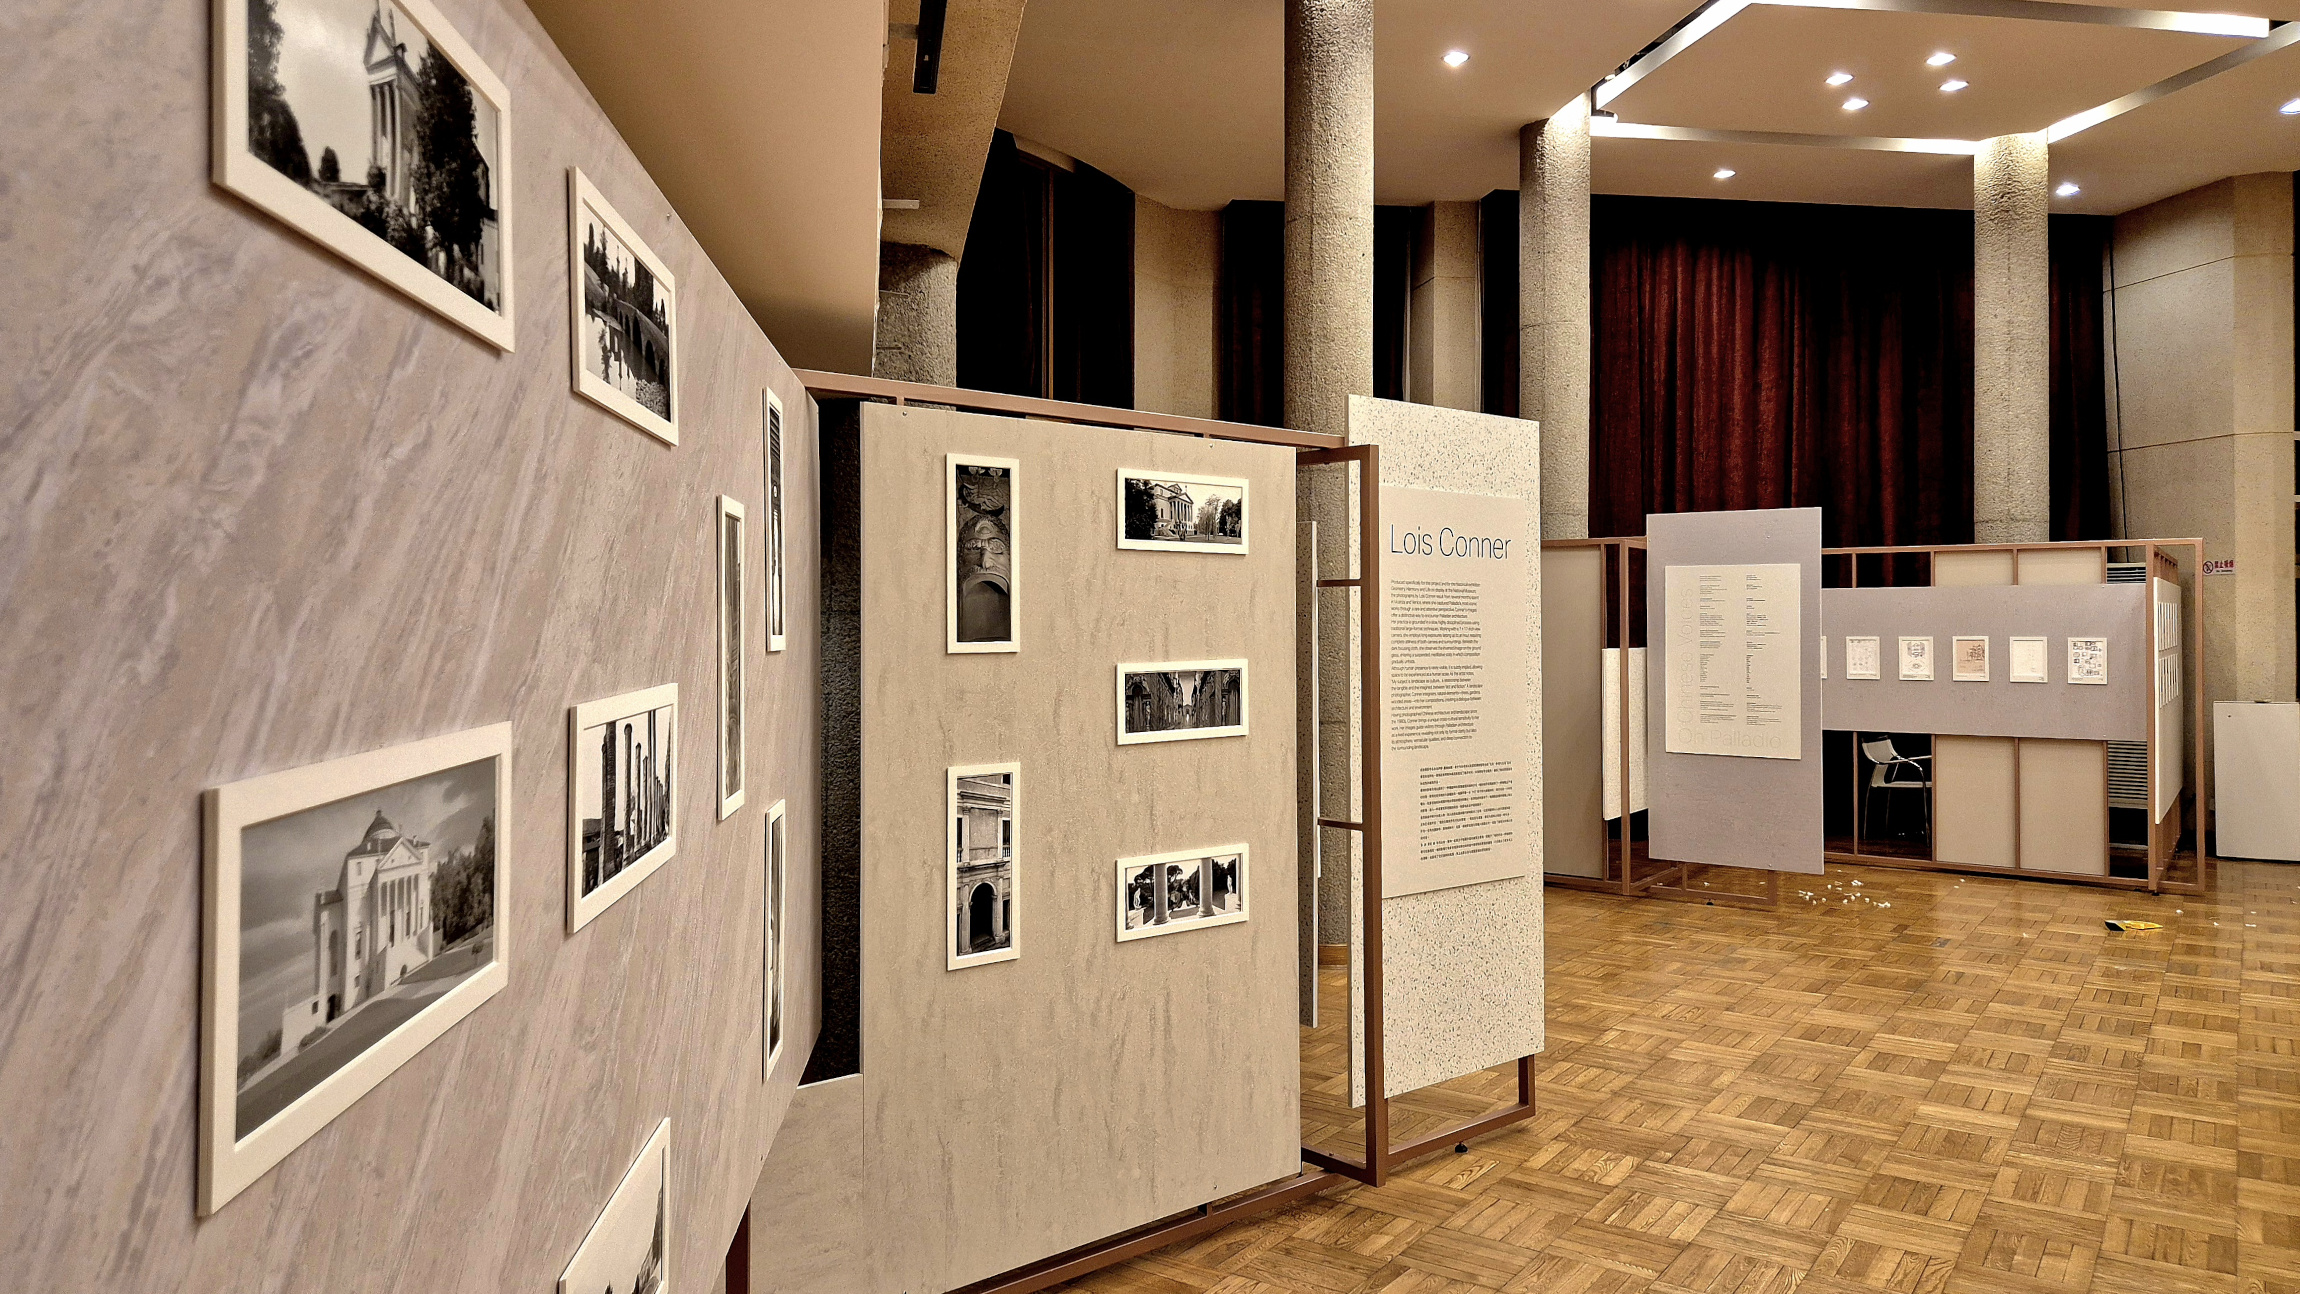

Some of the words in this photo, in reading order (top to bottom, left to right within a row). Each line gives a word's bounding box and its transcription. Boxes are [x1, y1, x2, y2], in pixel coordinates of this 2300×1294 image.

[1391, 524, 1433, 556] Lois
[1439, 527, 1512, 560] Conner
[1677, 588, 1694, 646] Voices
[1677, 652, 1694, 722] Chinese
[1678, 728, 1704, 744] On
[1710, 729, 1781, 749] Palladio
